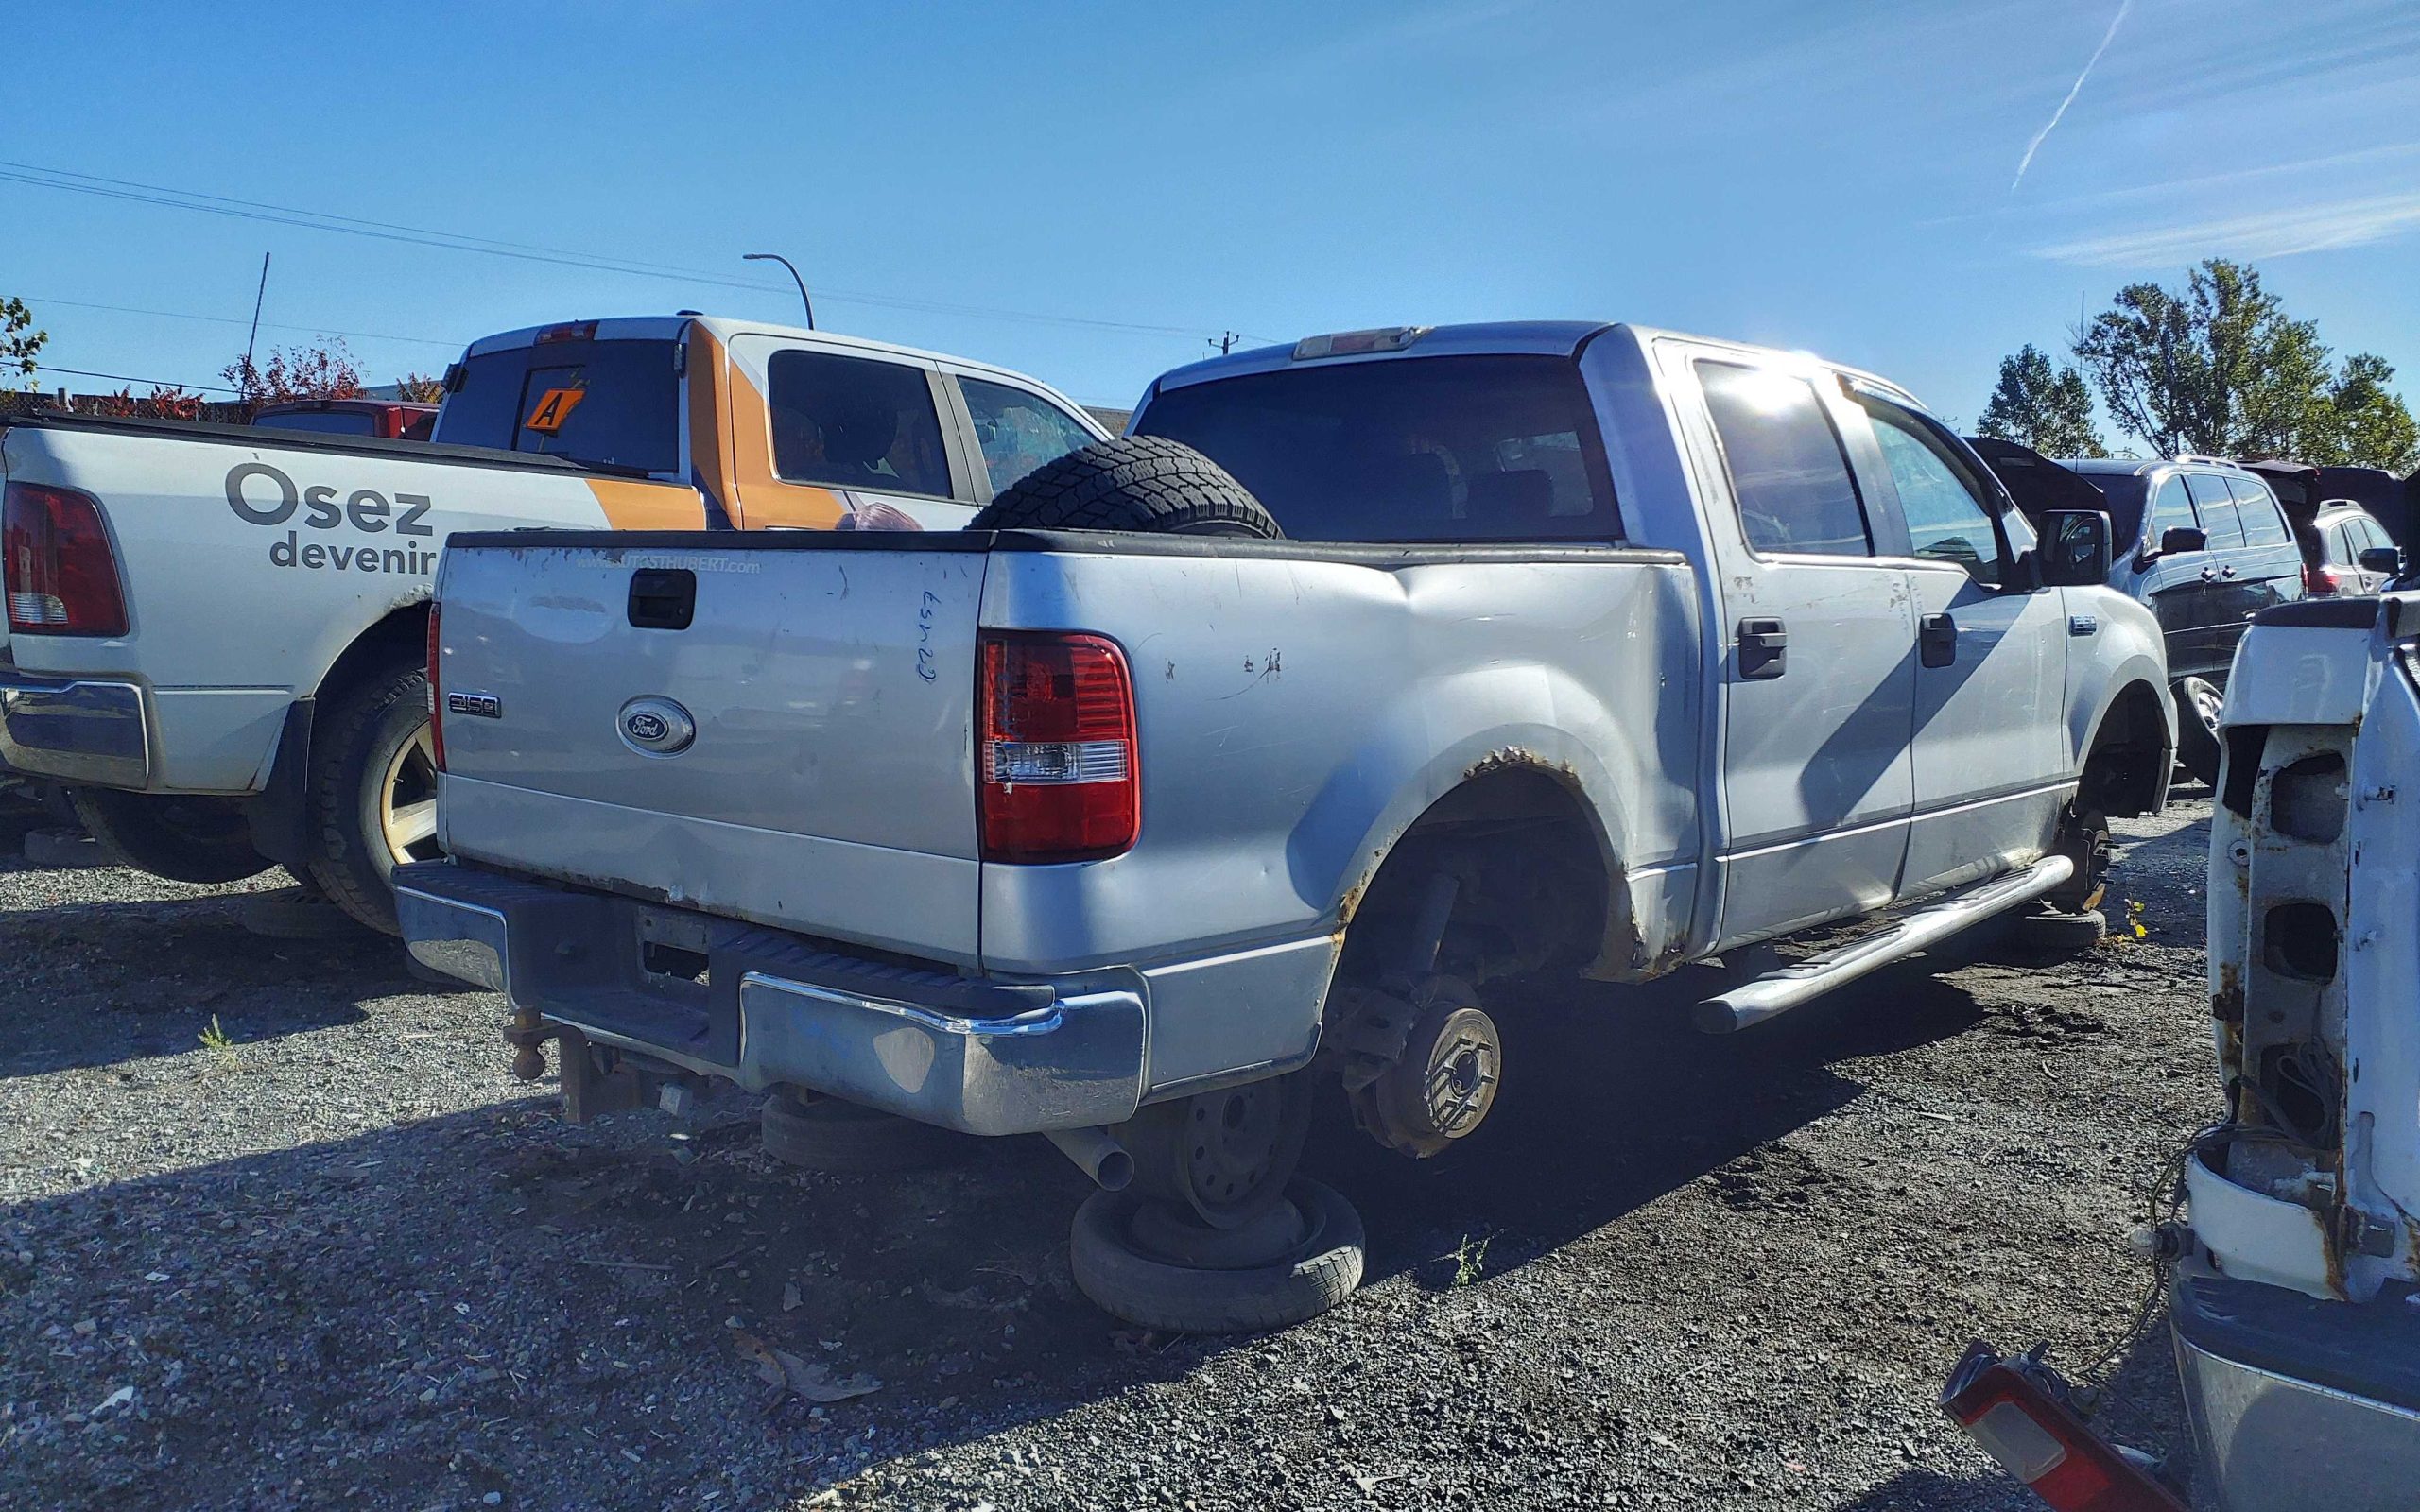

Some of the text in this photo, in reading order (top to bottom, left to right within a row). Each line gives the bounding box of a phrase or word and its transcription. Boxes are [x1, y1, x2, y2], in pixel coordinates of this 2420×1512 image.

[534, 392, 564, 425] A
[225, 462, 433, 536] Osez
[269, 531, 437, 575] devenir
[632, 715, 659, 737] Ford
